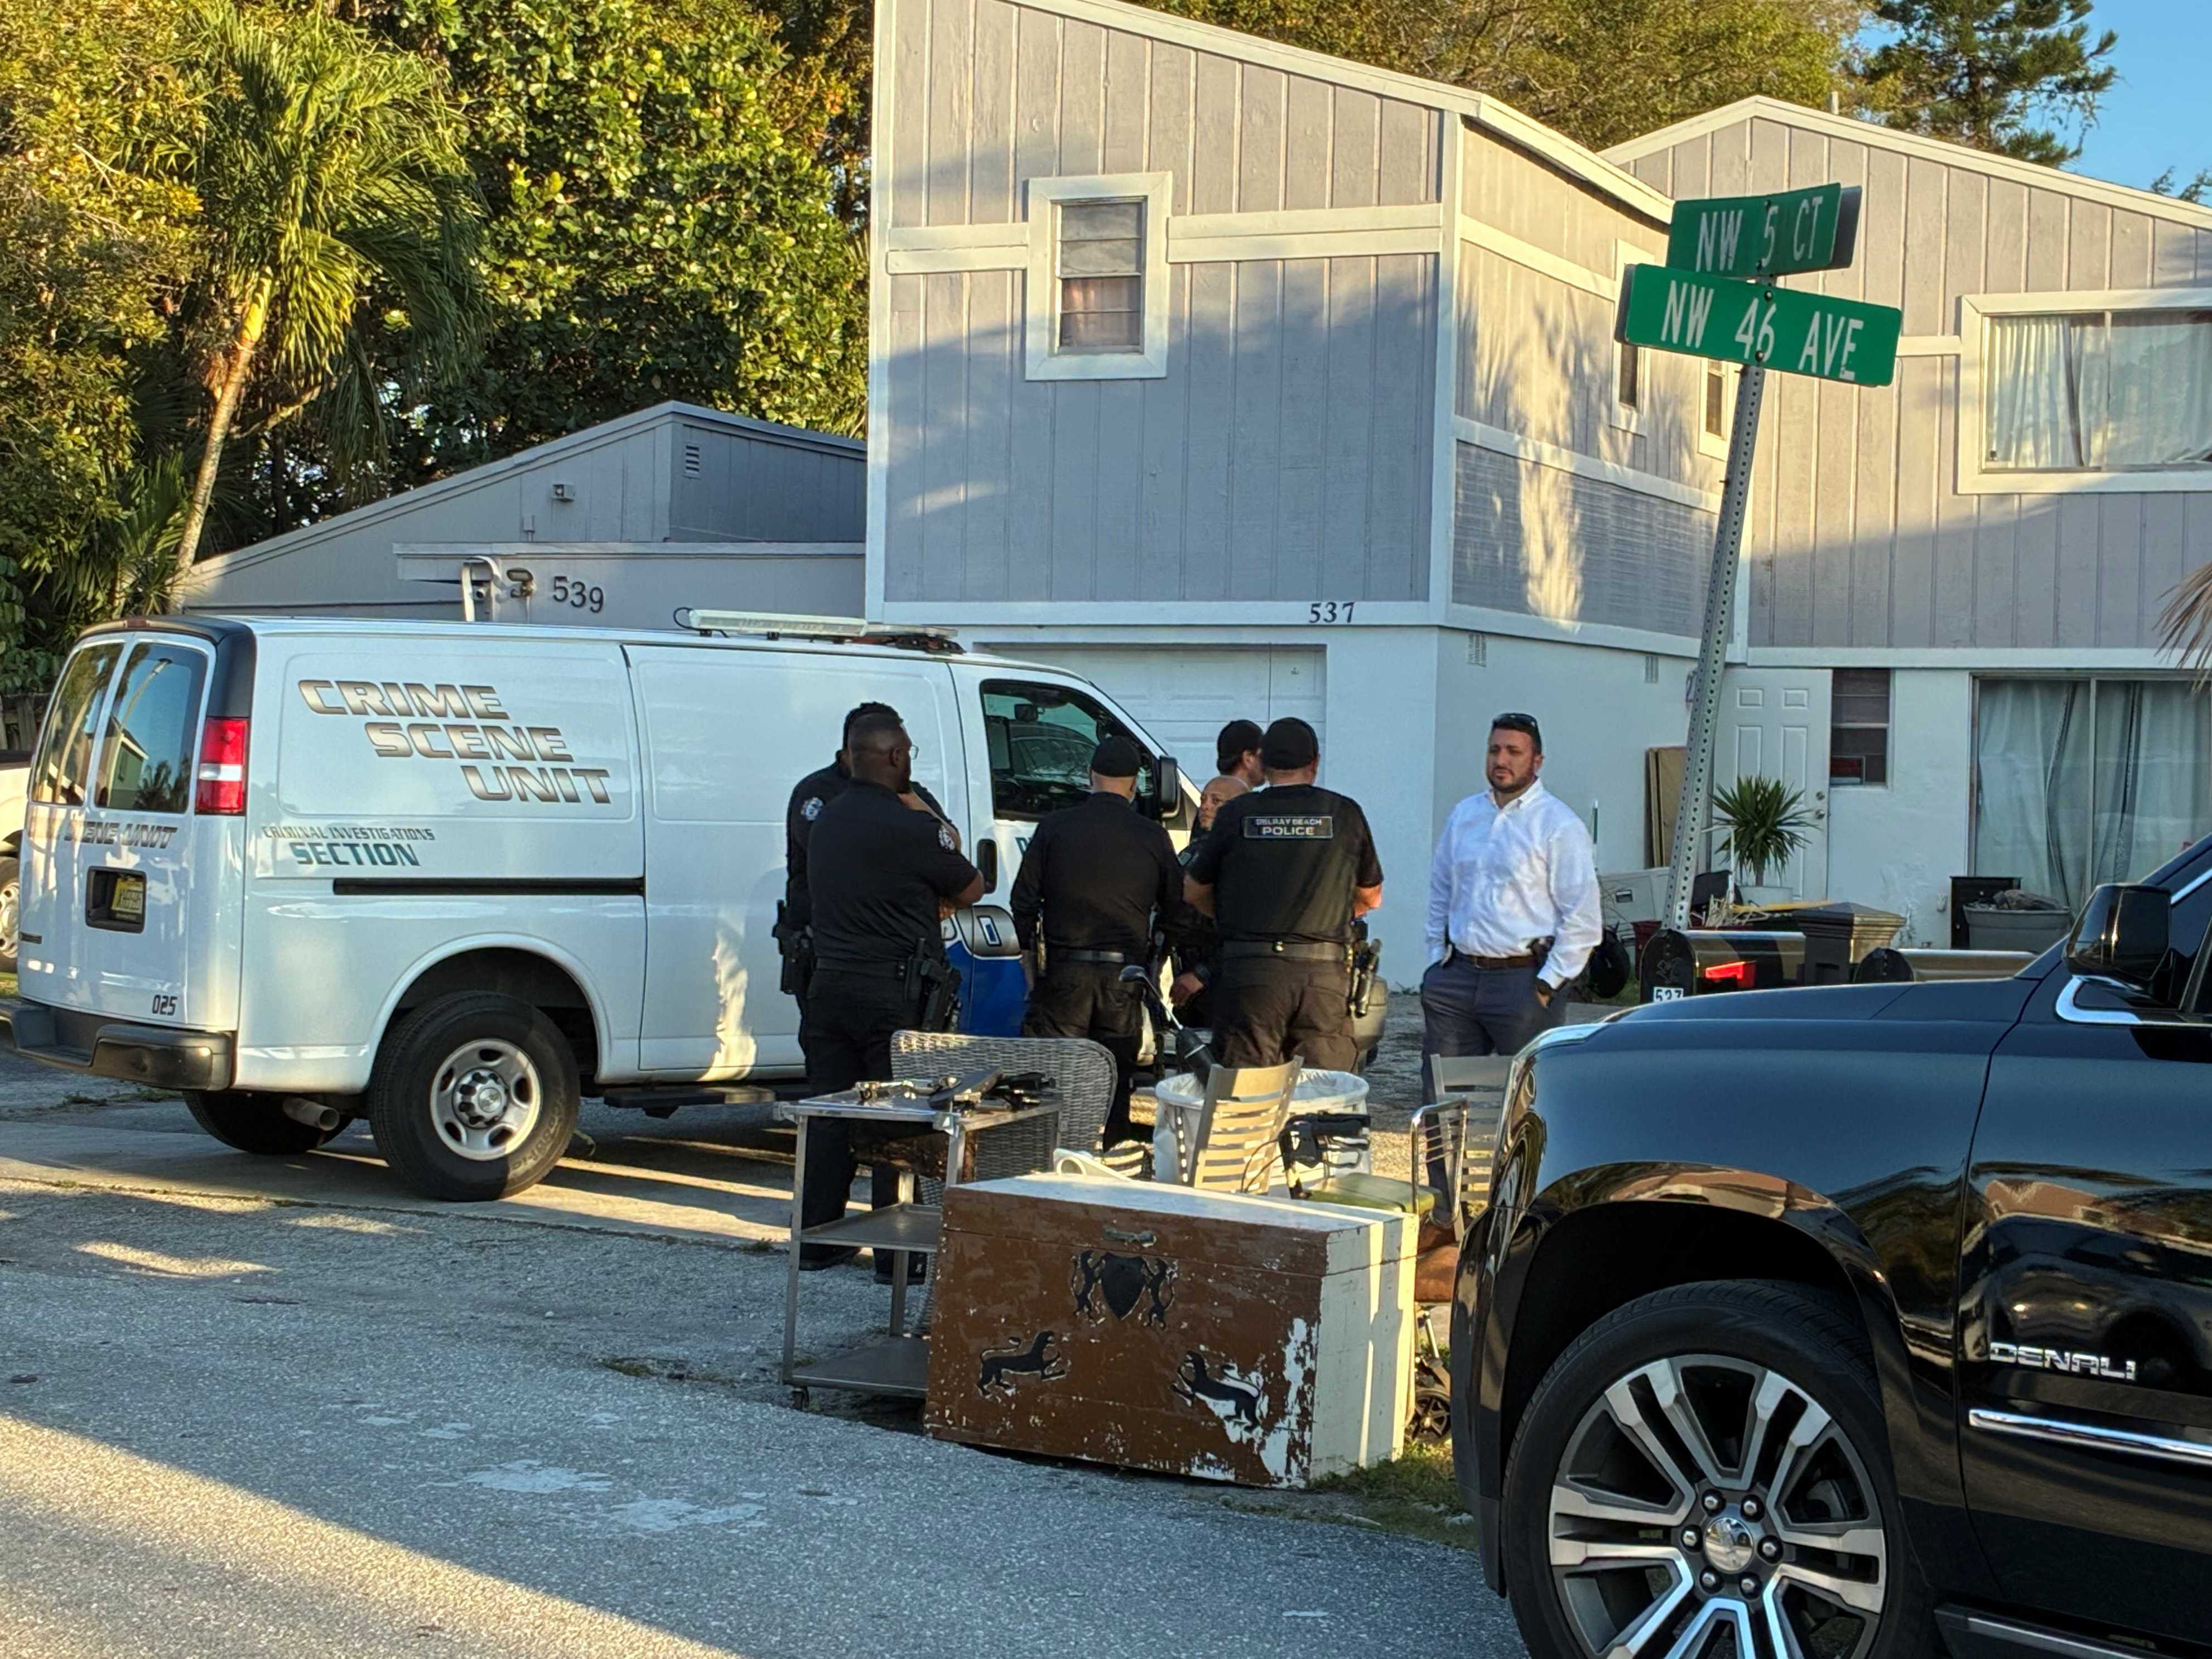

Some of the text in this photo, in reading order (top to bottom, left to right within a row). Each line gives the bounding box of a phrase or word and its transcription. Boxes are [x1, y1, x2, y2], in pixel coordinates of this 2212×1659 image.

[1696, 196, 1824, 272] NW 5 CT
[1661, 280, 1864, 381] NW 46 AVE
[553, 576, 605, 614] 539
[1309, 601, 1355, 623] 537
[298, 679, 510, 720] CRIME
[365, 722, 574, 763] SCENE
[461, 765, 611, 804] UNIT
[64, 822, 178, 848] ENE UNIT
[262, 826, 435, 841] CRIMINAL INVESTIGATIONS
[1262, 827, 1315, 835] POLICE
[289, 842, 420, 866] SECTION
[152, 994, 178, 1016] 025
[1989, 1342, 2136, 1381] DENALI
